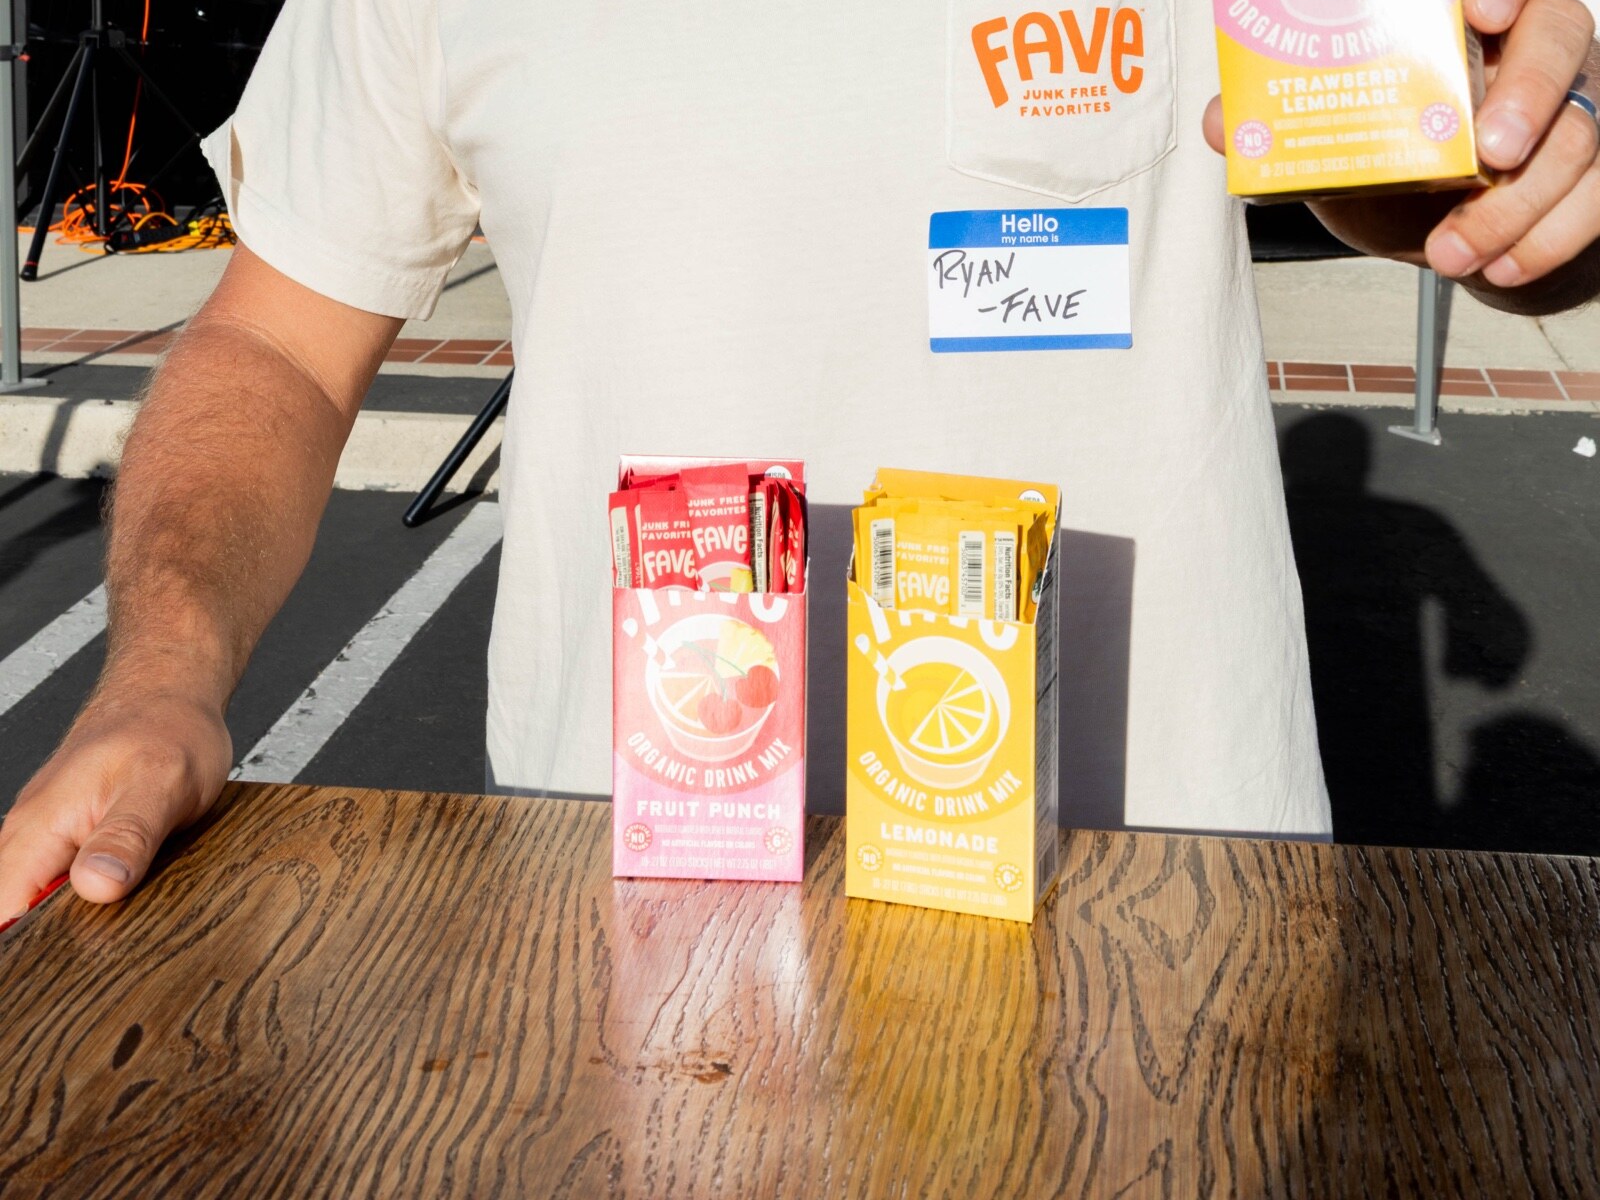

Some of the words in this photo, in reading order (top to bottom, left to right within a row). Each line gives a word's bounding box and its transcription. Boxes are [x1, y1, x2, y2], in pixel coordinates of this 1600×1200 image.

[1267, 67, 1409, 96] STRAWBERRY
[1023, 89, 1065, 100] JUNK
[1070, 85, 1108, 98] FREE
[1282, 87, 1399, 114] LEMONADE
[1020, 101, 1111, 117] FAVORITES
[1244, 133, 1262, 147] NO
[1001, 213, 1059, 233] Hello
[1001, 235, 1016, 245] my
[1019, 234, 1049, 243] name
[1051, 233, 1059, 243] is
[933, 249, 1015, 298] RYAN
[688, 498, 715, 508] JUNK
[720, 495, 746, 504] FREE
[688, 505, 746, 517] FAVORITES
[642, 521, 669, 530] JUNK
[755, 545, 763, 562] Facts
[1004, 546, 1012, 578] Nutrition
[628, 731, 697, 785] ORGANIC
[704, 760, 758, 788] DRINK
[758, 737, 792, 771] MIX
[859, 751, 927, 811] ORGANIC
[935, 791, 988, 816] DRINK
[989, 770, 1022, 804] MIX
[636, 800, 700, 817] FRUIT
[709, 802, 780, 820] PUNCH
[631, 832, 645, 843] NO
[881, 822, 998, 855] LEMONADE
